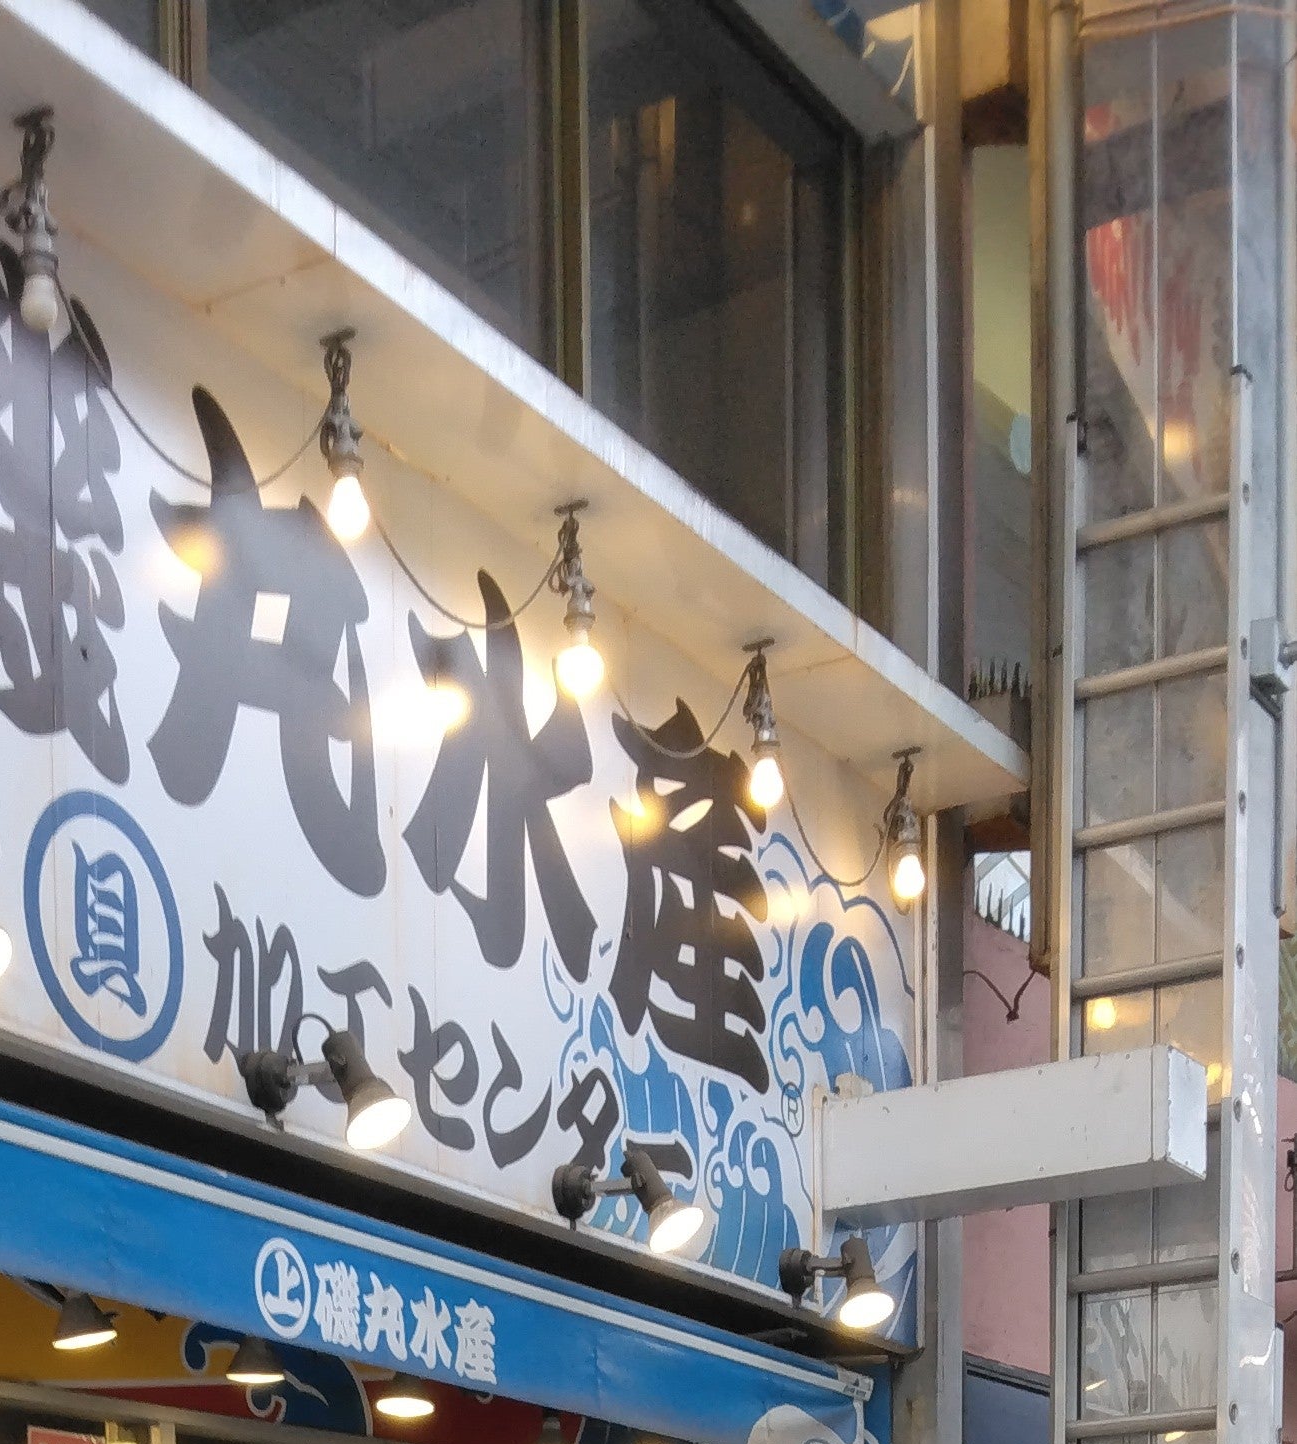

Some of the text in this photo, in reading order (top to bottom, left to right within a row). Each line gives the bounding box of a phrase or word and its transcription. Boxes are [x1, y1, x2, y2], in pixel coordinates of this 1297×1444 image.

[203, 884, 689, 1178] 加工センター
[313, 1260, 497, 1385] 磯丸水産
